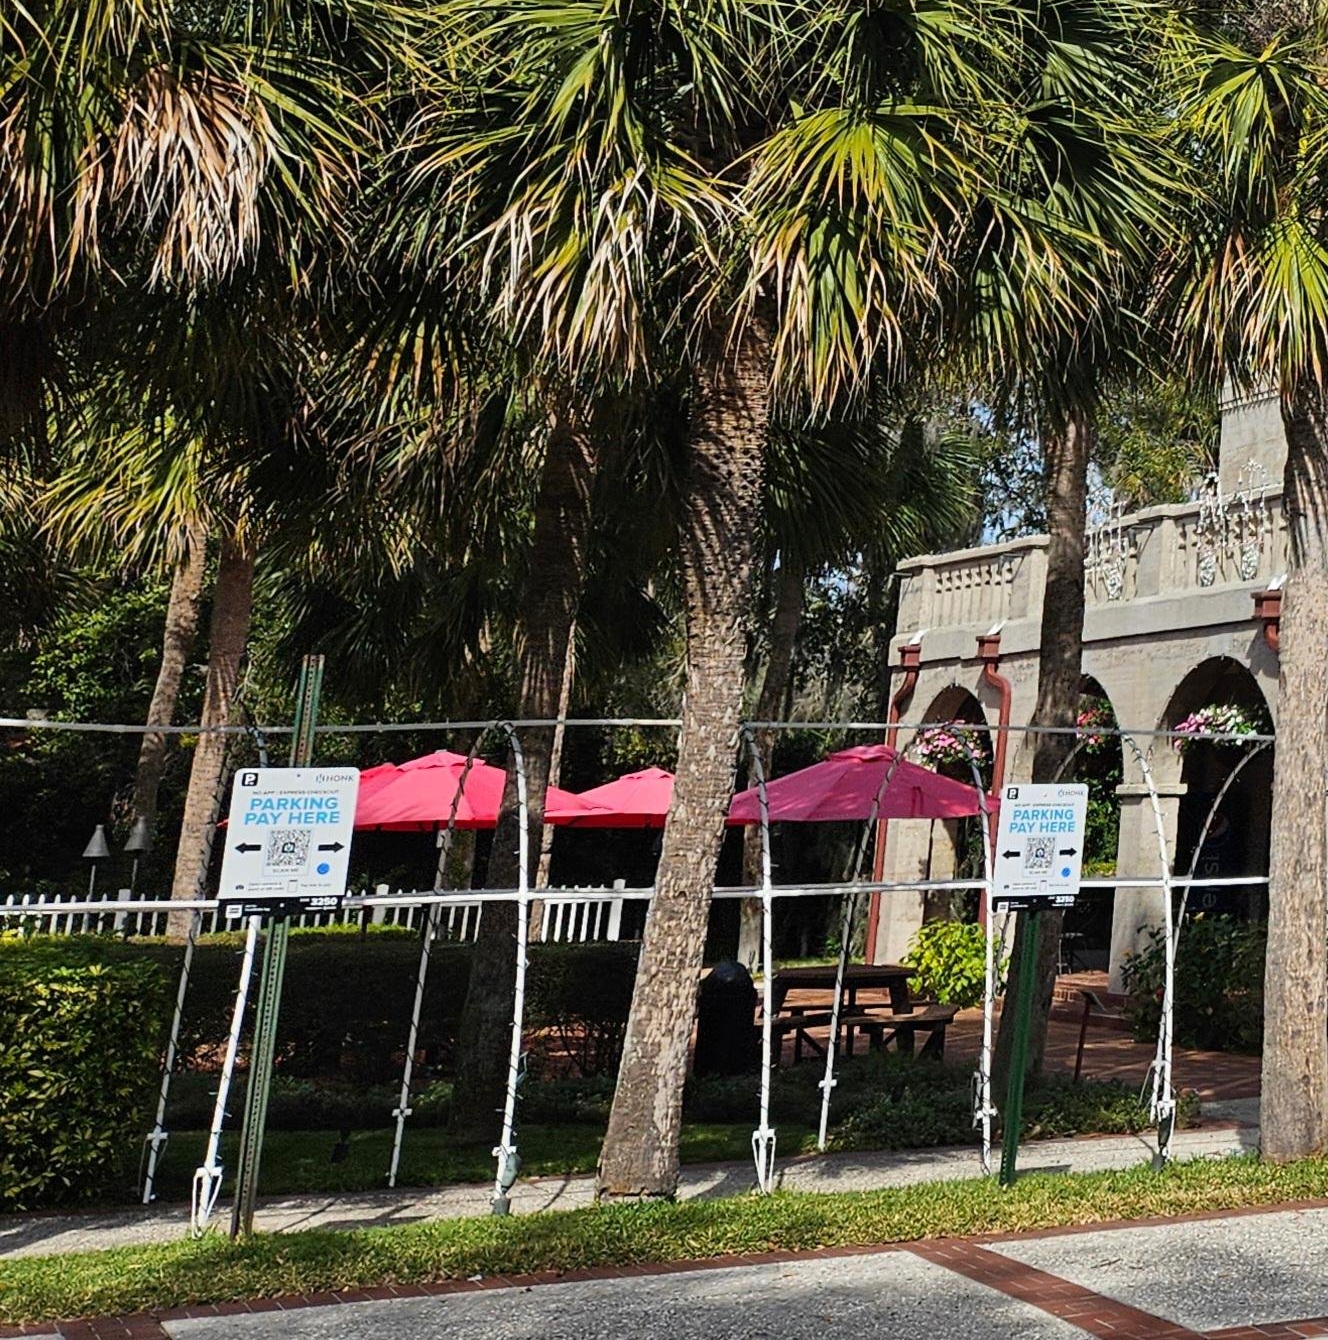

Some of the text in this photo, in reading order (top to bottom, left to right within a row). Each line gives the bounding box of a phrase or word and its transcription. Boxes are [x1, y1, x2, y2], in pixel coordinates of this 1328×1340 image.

[250, 797, 338, 811] PARKING
[244, 811, 340, 825] PAY HERE
[1013, 809, 1074, 820] PARKING
[1009, 821, 1076, 833] PAY HERE
